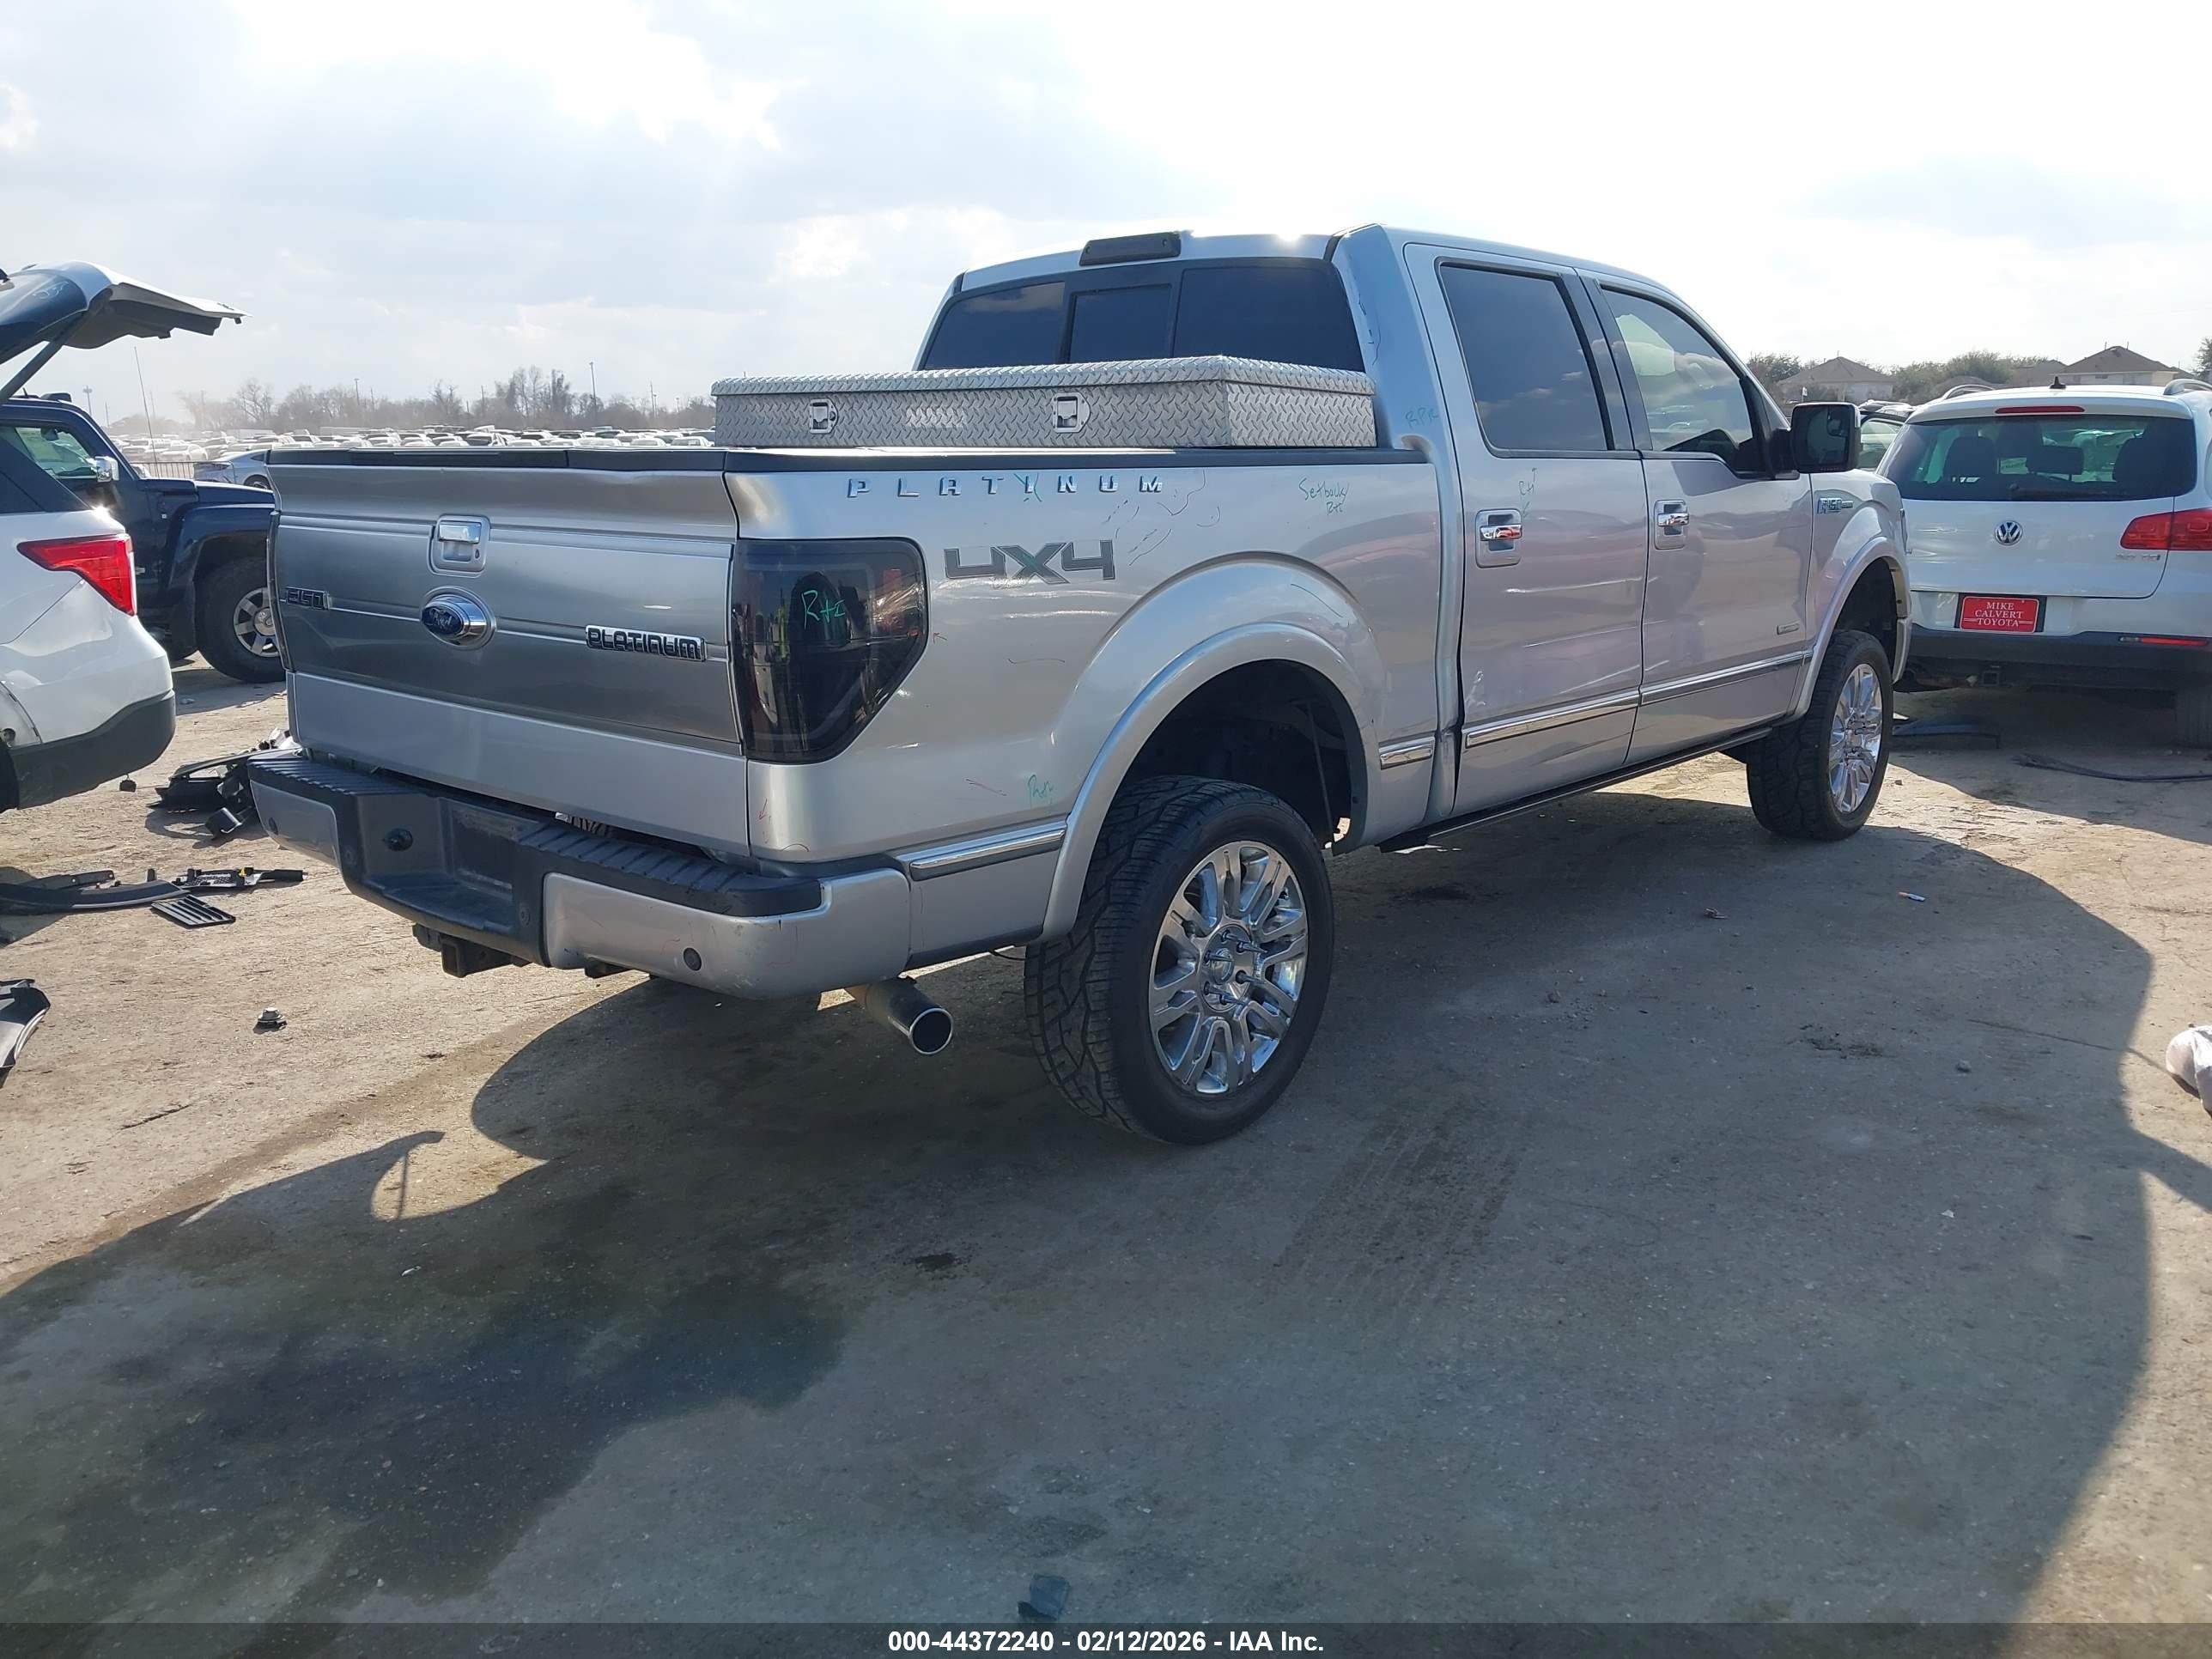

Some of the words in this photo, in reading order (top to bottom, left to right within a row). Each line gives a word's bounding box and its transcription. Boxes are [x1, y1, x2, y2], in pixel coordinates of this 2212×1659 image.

[847, 476, 1163, 498] PLATINUM
[1986, 602, 2014, 611] MIKE
[1974, 610, 2024, 619] CALVERT
[1977, 617, 2020, 627] TOYOTA
[586, 626, 702, 661] PLATINUM
